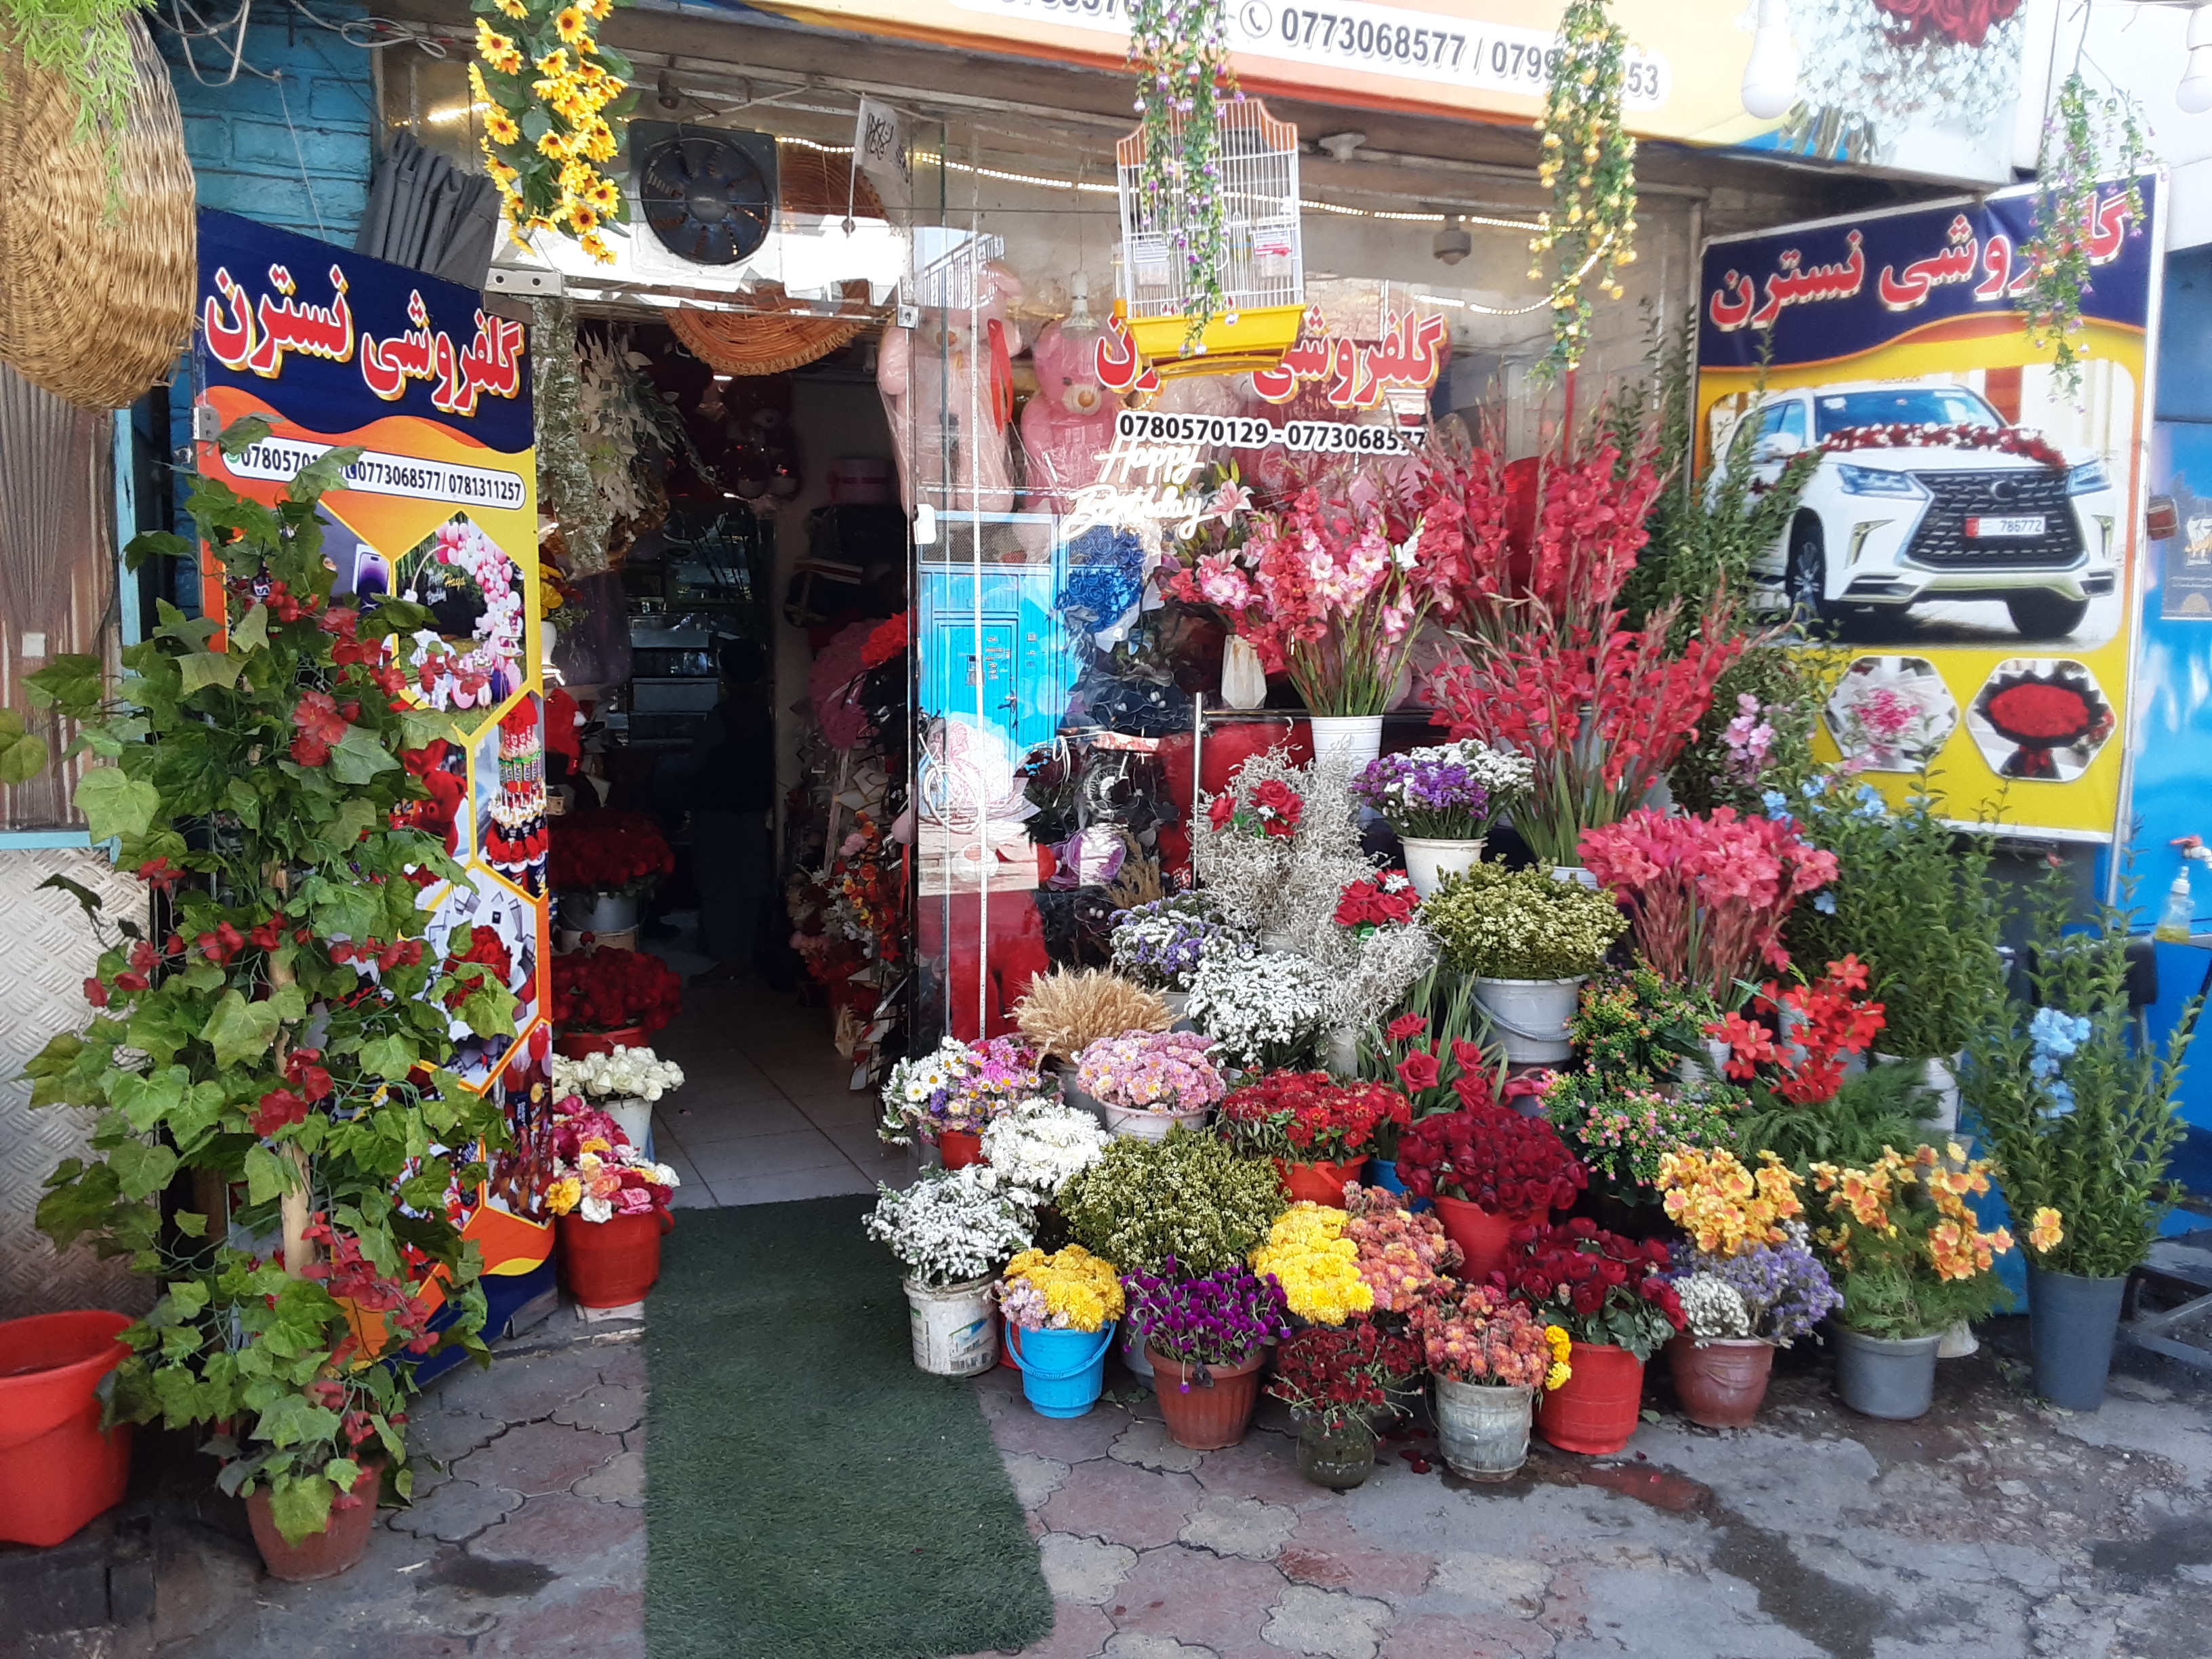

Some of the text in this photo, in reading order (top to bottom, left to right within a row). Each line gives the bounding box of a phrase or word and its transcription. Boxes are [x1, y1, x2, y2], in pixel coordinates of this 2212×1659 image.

[1282, 9, 1466, 70] 0773068577
[1709, 230, 1865, 331] نسترن
[204, 264, 524, 417] گلفروشی نسترن
[1120, 414, 1269, 444] 0780570129
[1092, 436, 1205, 484] Happy
[448, 475, 521, 502] 0781311257
